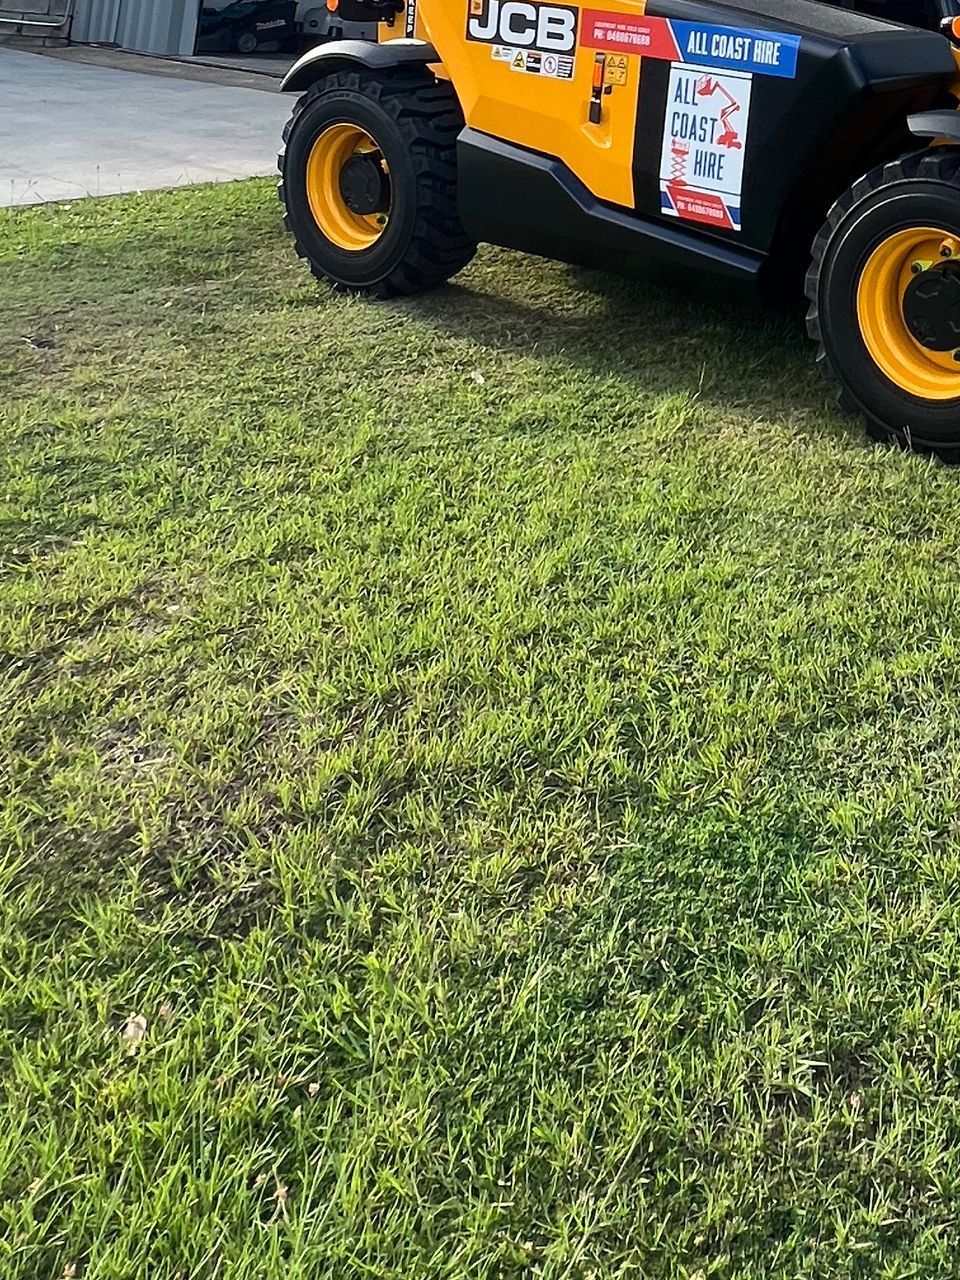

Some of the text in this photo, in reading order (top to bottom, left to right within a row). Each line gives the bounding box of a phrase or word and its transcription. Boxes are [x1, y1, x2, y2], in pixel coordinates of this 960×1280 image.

[468, 0, 576, 51] JCB
[686, 30, 781, 66] ALL COAST HIRE
[673, 77, 699, 106] ALL
[670, 111, 719, 145] COAST
[693, 149, 726, 181] HIRE
